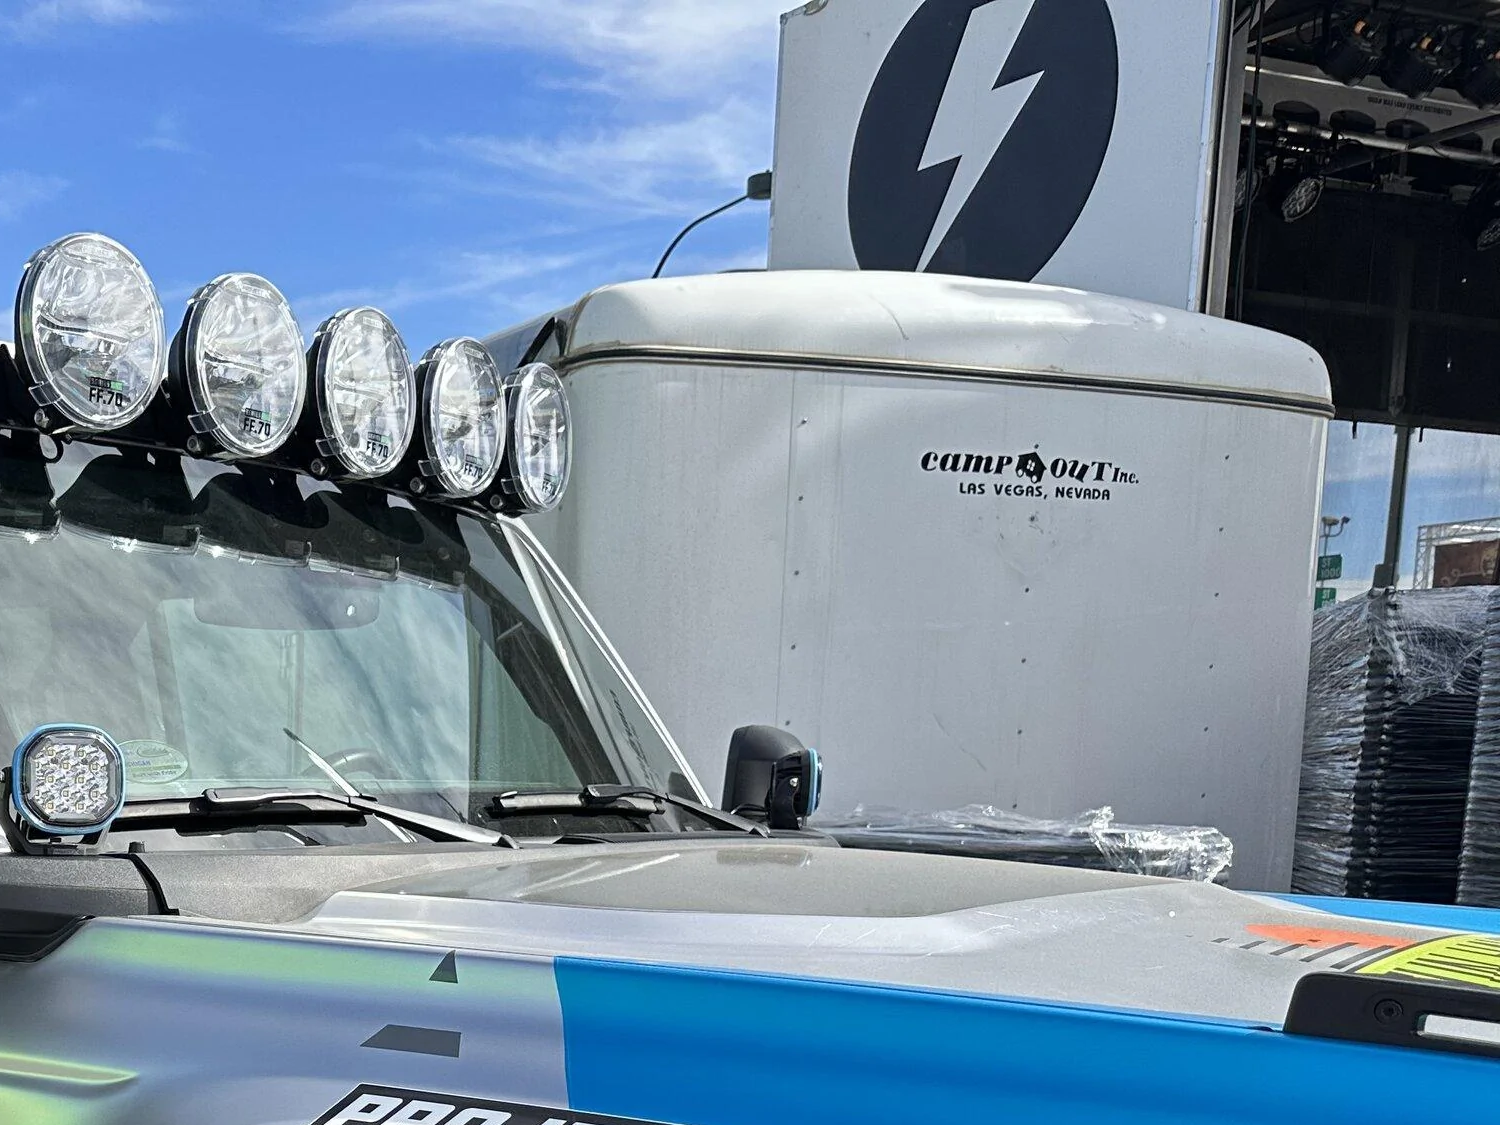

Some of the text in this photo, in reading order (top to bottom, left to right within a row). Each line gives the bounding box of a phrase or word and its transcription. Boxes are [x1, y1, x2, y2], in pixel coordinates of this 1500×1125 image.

[89, 387, 123, 407] FF.70
[959, 482, 1111, 501] LAS VEGAS, NEVADA
